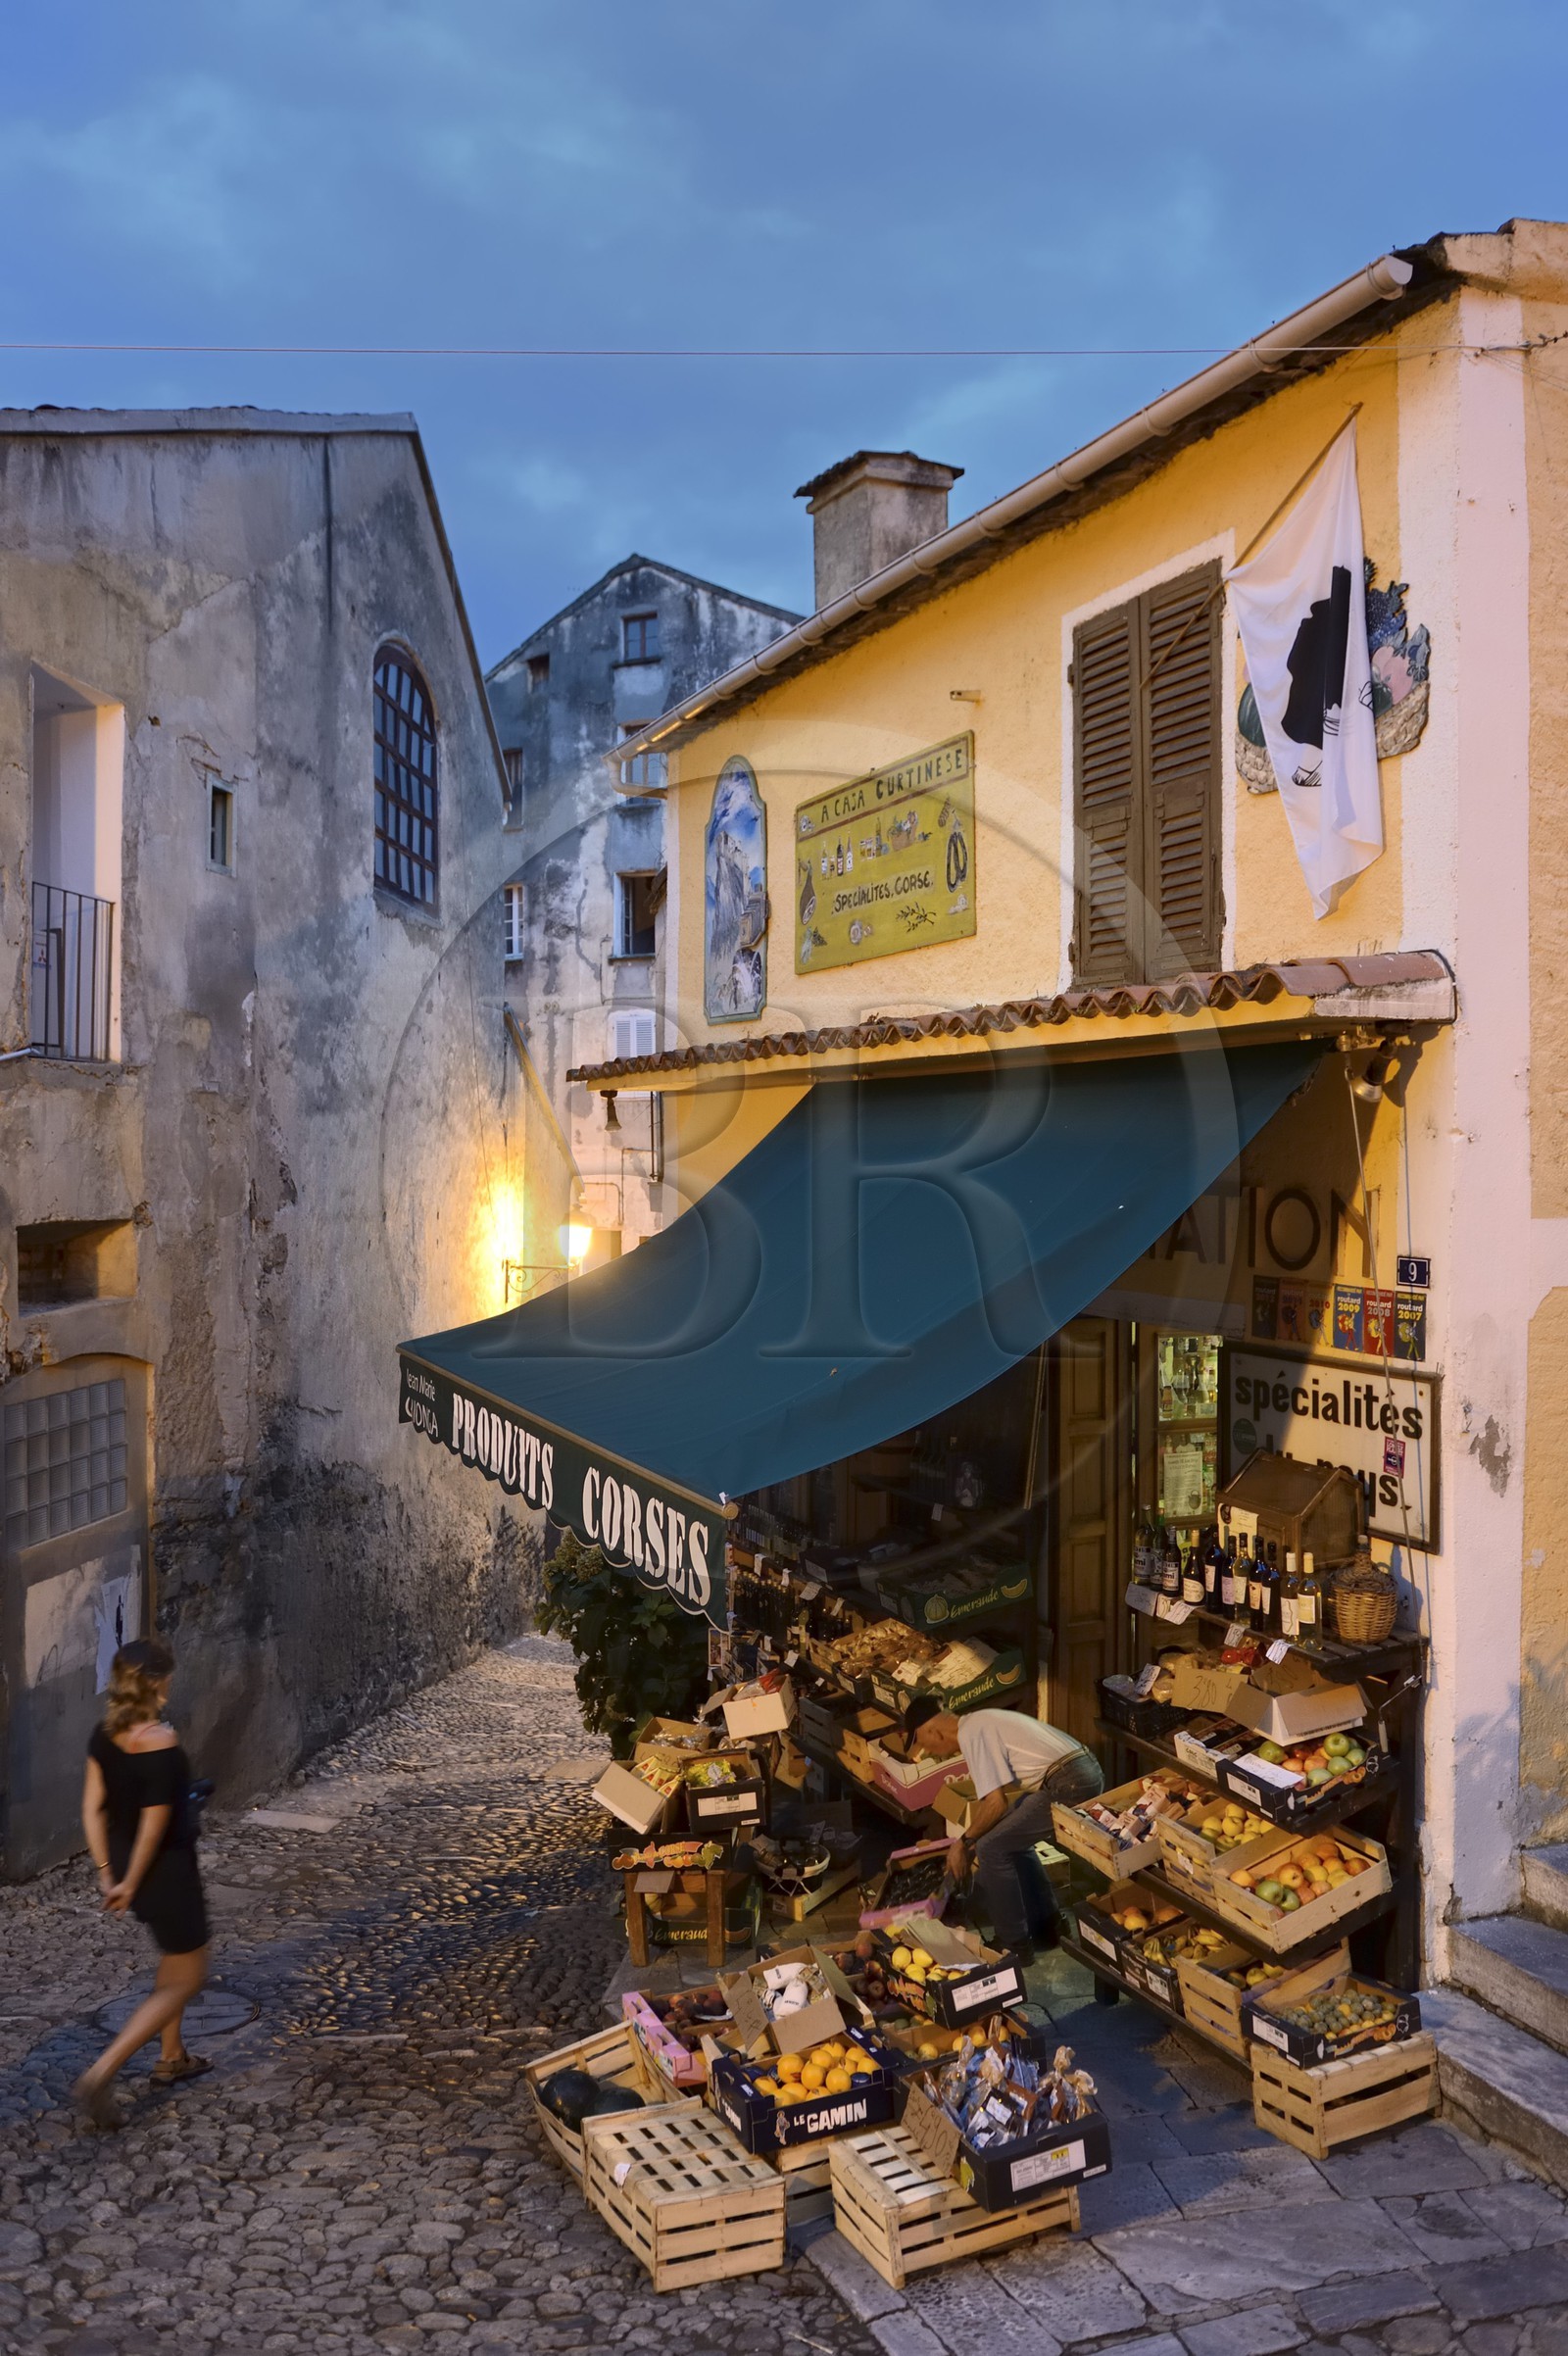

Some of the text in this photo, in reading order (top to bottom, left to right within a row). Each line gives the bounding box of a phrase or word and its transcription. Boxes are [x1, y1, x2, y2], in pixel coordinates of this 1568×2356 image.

[820, 808, 829, 823] A
[875, 749, 962, 801] CURTINESE
[1148, 1187, 1370, 1278] ATION
[1408, 1262, 1417, 1282] 9
[1337, 1296, 1361, 1304] routard
[1338, 1302, 1360, 1313] 2009
[1366, 1300, 1392, 1308] rouard
[1396, 1302, 1423, 1312] routard
[1367, 1306, 1391, 1317] 2008
[1397, 1309, 1422, 1321] 2007
[406, 1368, 418, 1392] Jean
[1235, 1370, 1423, 1440] spécialités
[451, 1392, 711, 1606] PRODUITS CORSES
[948, 1676, 996, 1710] Emeraude
[654, 1927, 709, 1941] Emeraud
[793, 2098, 867, 2134] LE GAMIN
